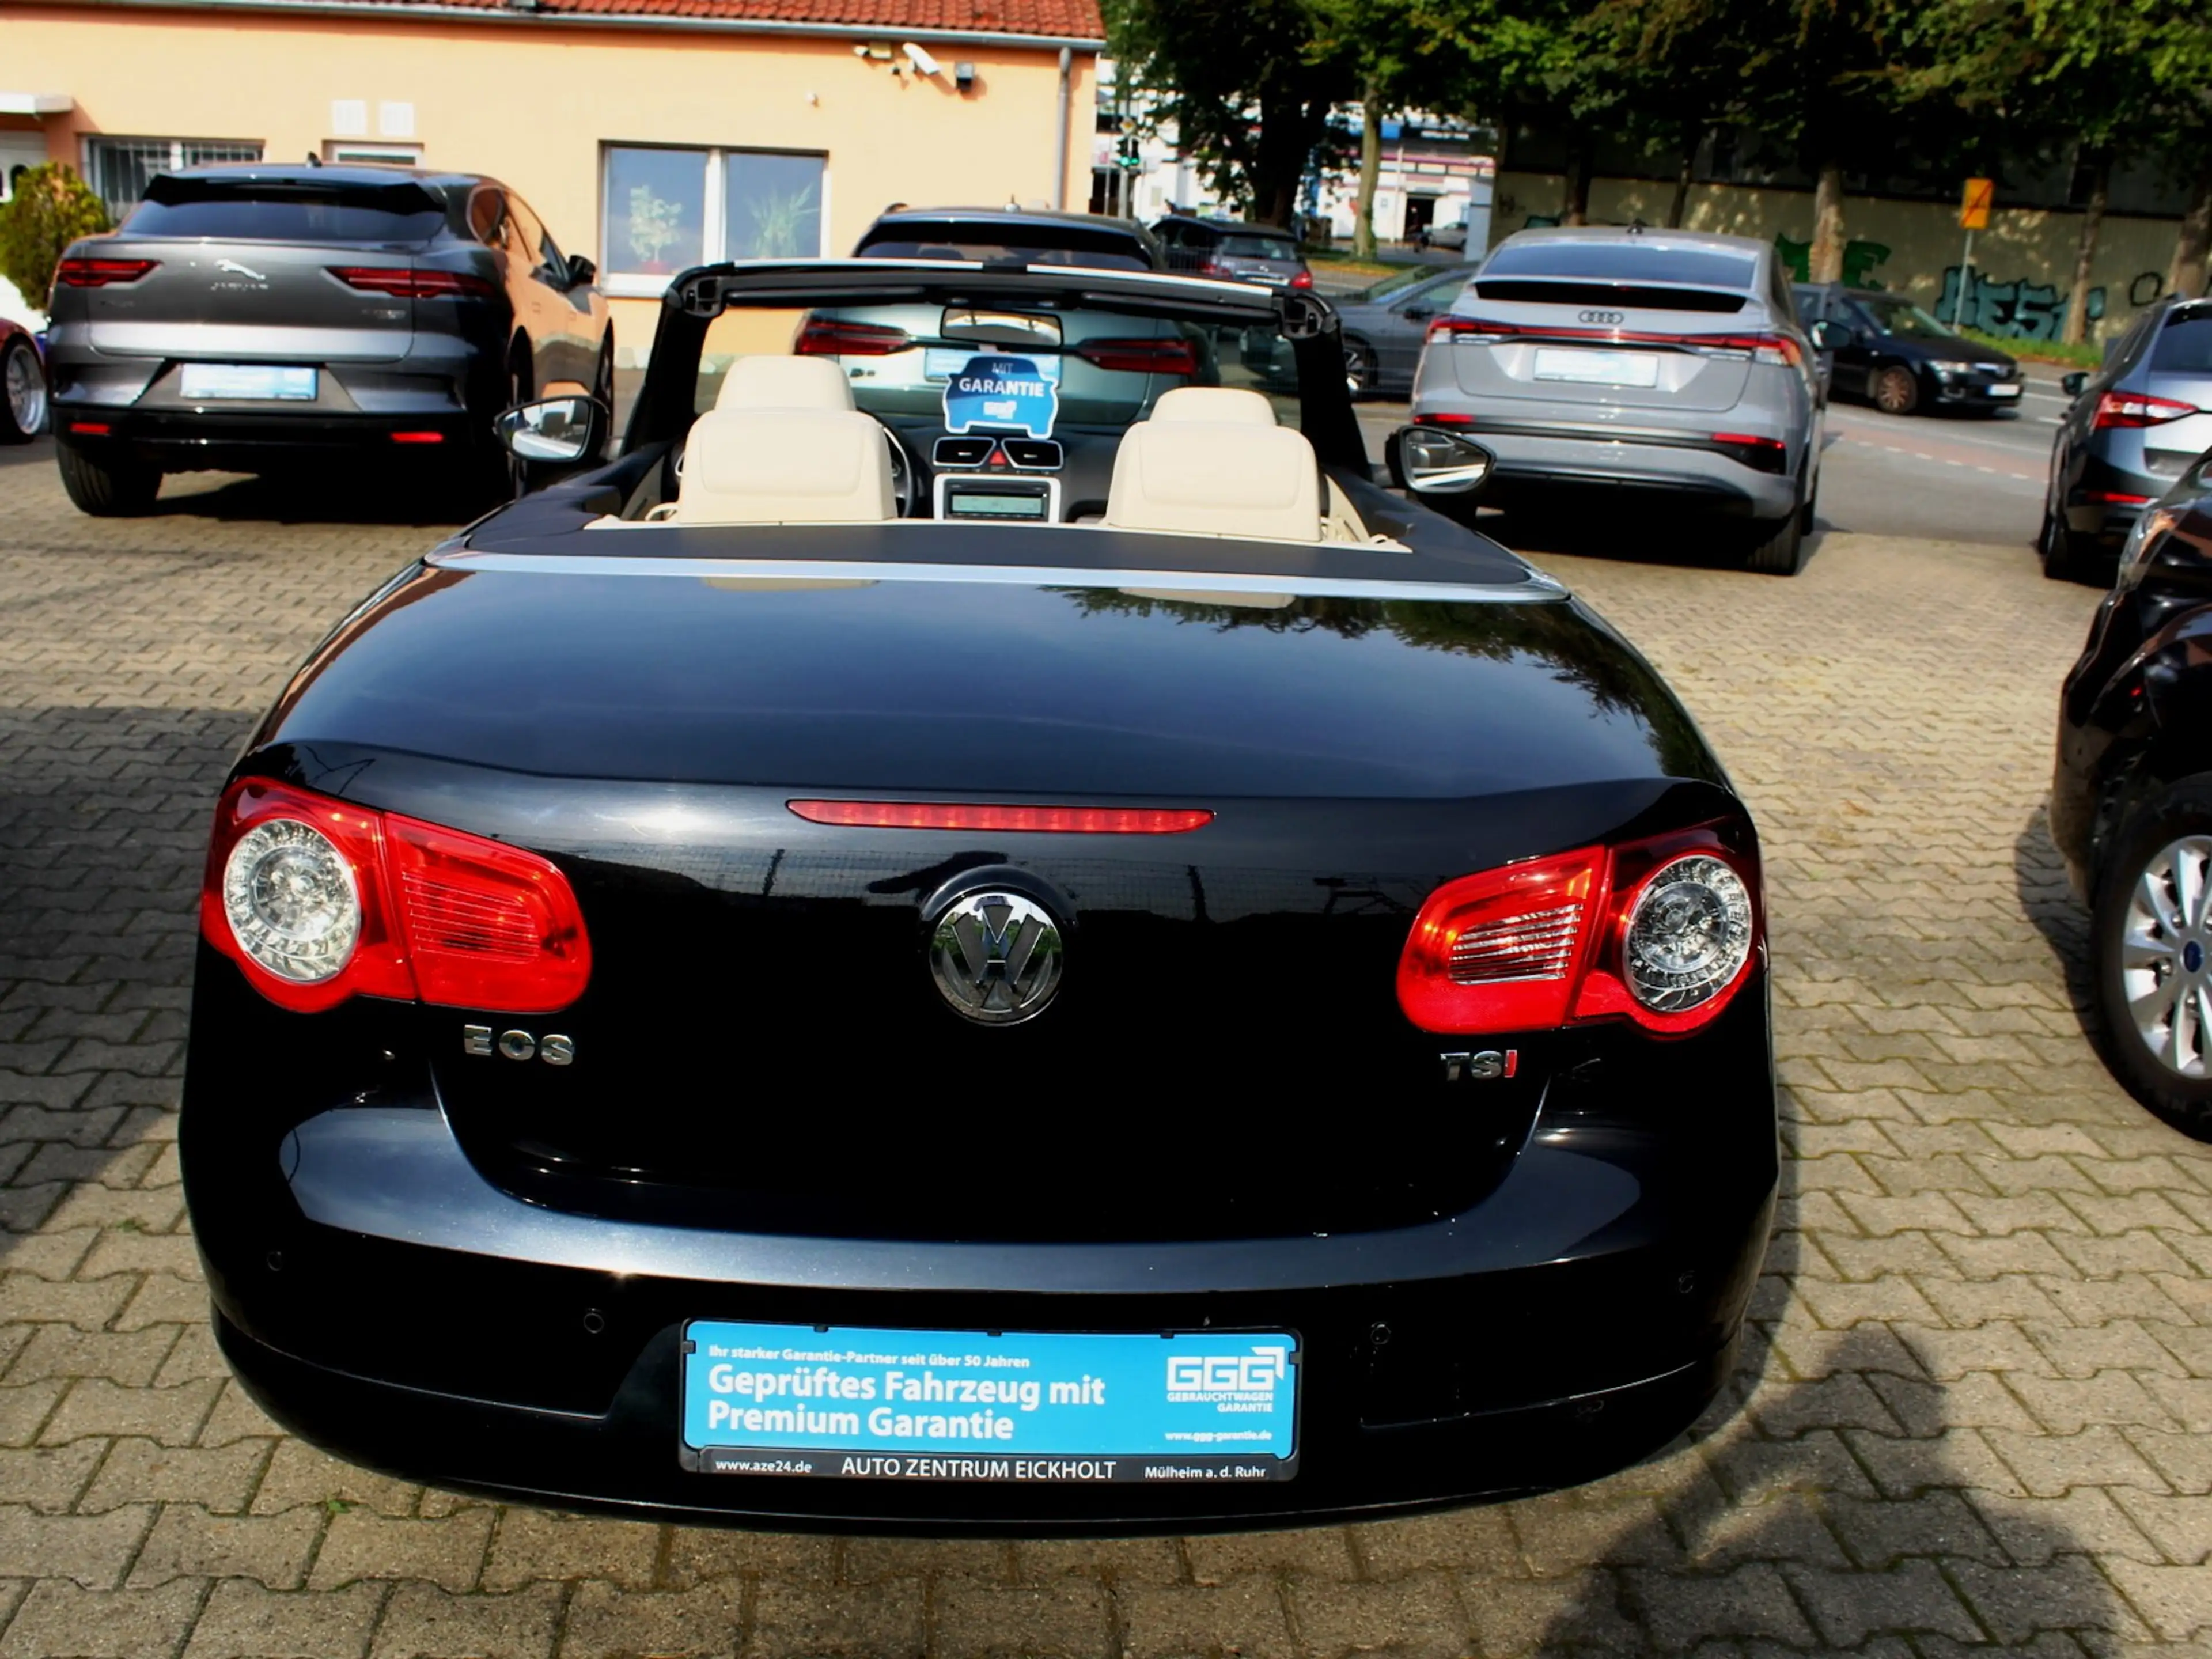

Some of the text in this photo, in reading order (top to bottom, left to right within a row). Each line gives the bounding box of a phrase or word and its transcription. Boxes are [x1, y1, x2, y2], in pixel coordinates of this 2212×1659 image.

[991, 362, 1014, 375] MIT
[959, 377, 1045, 397] GARANTIE
[464, 1024, 574, 1066] EOS
[1440, 1049, 1518, 1081] TSI
[709, 1345, 1030, 1368] Ihr starker Garantie-Partner seit über 50 Jahren
[1166, 1355, 1274, 1391] GGG
[709, 1363, 1106, 1411] Geprüftes Fahrzeug mit
[1167, 1391, 1273, 1403] GEBRAUCHTWAGEN
[1217, 1402, 1273, 1412] GARANTIE
[709, 1400, 1014, 1440] Premium Garantie
[1165, 1430, 1272, 1442] www.ggg-garantie.de
[715, 1457, 1266, 1479] www.aze24.de AUTO ZENTRUM EICKHOLT Mülheim a. d. Ruhr
